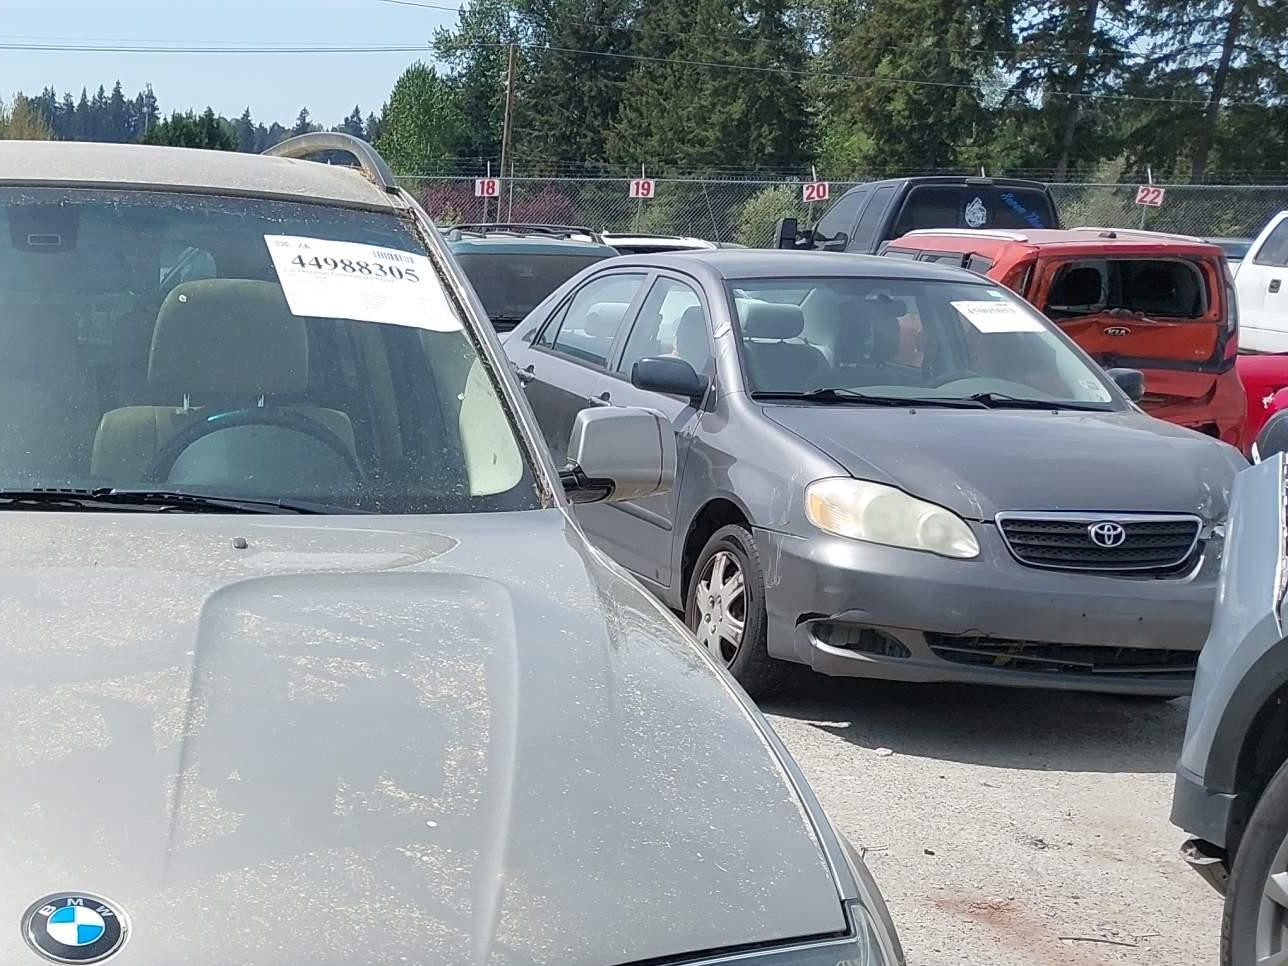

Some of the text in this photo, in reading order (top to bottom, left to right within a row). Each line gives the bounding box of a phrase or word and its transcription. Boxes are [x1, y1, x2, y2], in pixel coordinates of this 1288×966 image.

[479, 180, 495, 195] 18
[634, 181, 651, 196] 19
[806, 184, 826, 200] 20
[1140, 188, 1162, 205] 22
[291, 253, 421, 284] 44988305
[38, 898, 114, 917] BMW
